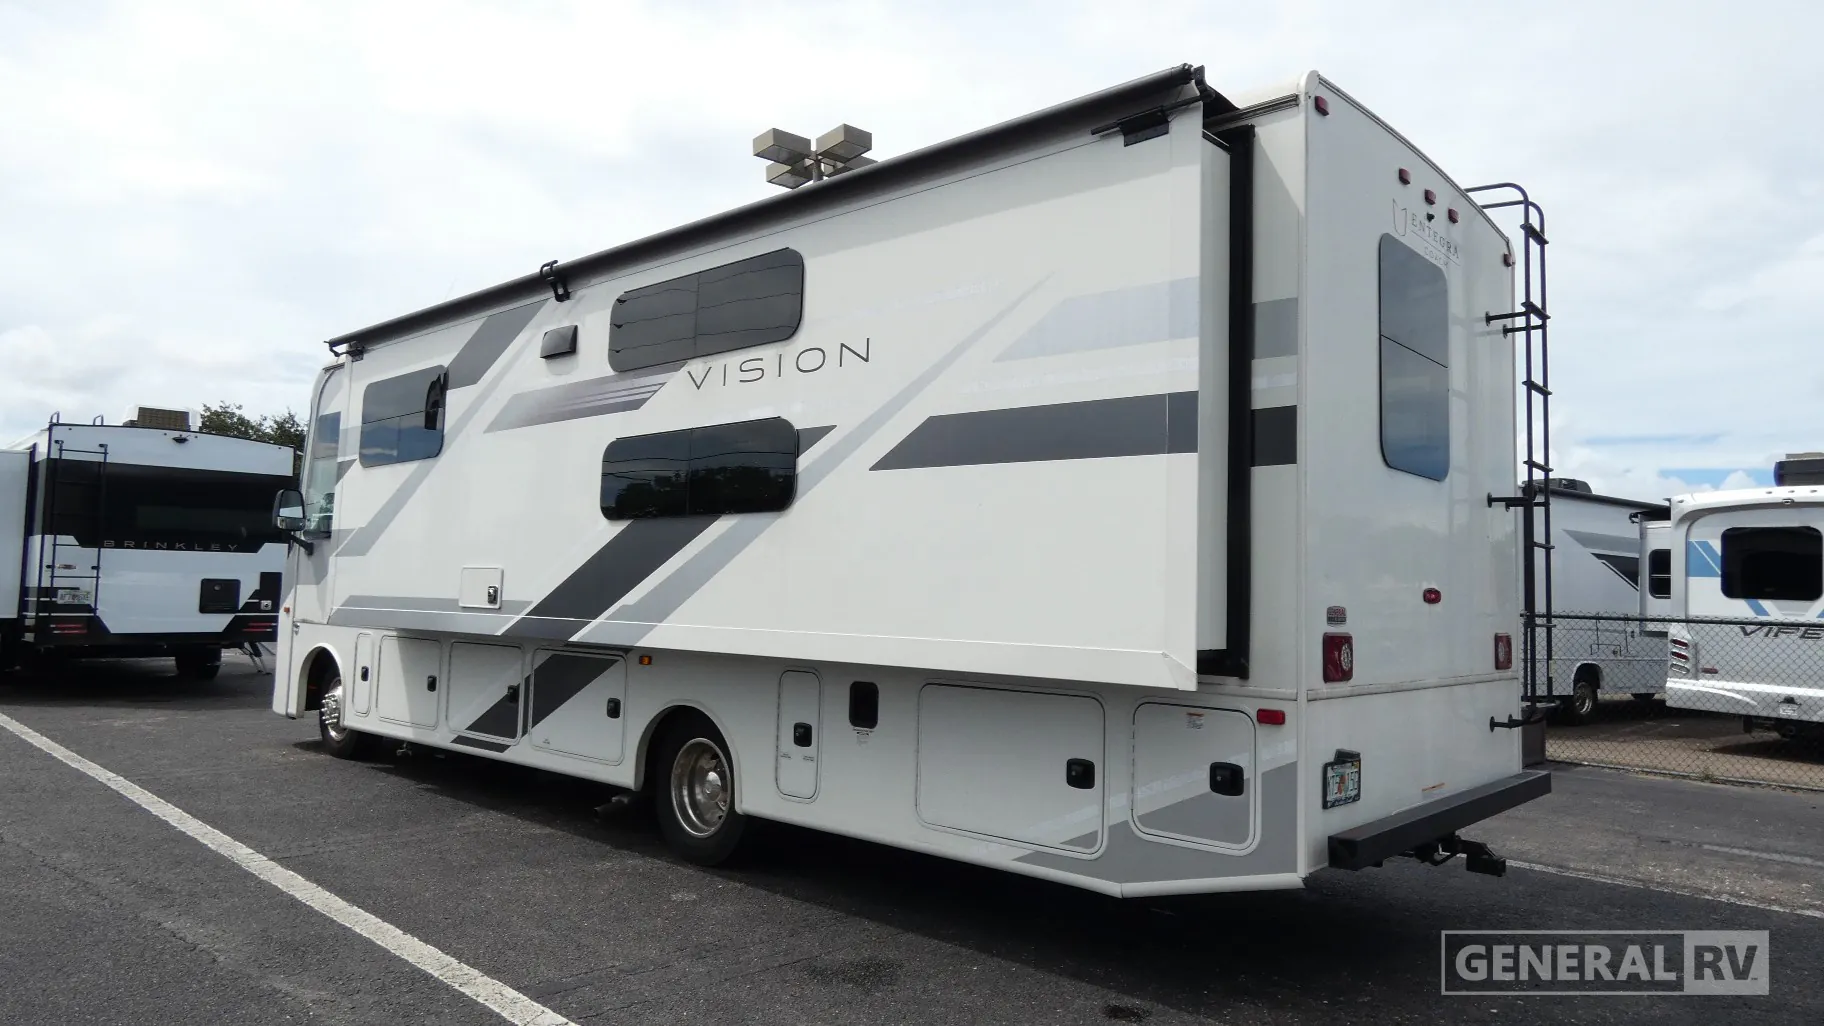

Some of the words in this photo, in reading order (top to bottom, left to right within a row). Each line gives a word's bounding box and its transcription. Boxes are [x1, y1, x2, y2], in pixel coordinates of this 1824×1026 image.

[1411, 213, 1459, 259] ENTEGRA
[687, 337, 870, 391] VISION
[103, 540, 238, 551] BRINKLEY
